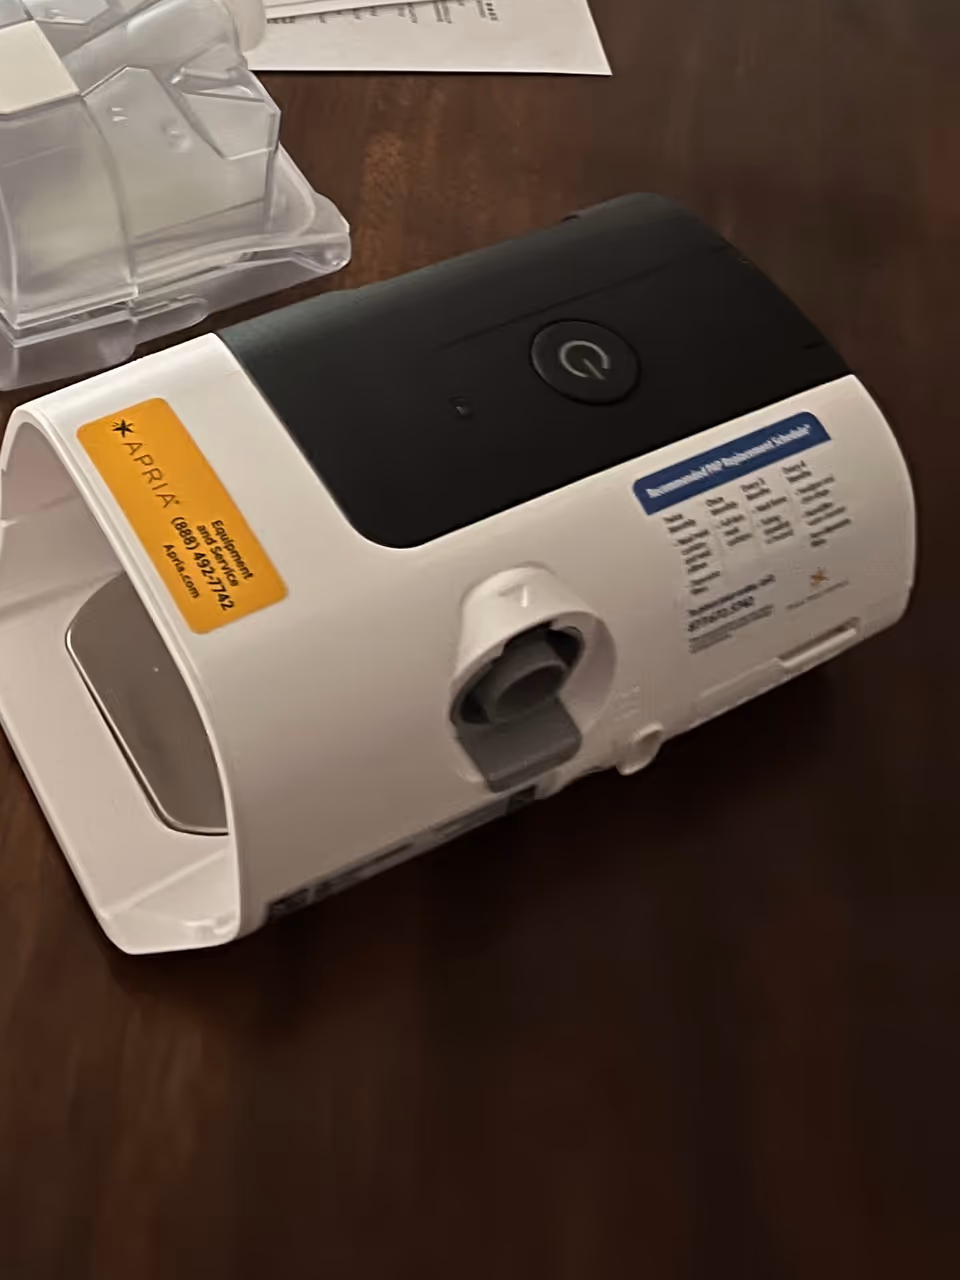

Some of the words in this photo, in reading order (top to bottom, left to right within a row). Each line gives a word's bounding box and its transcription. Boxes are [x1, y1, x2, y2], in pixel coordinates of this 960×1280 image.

[122, 442, 177, 508] APRIA
[162, 544, 200, 599] Apria.com
[170, 516, 200, 550] (888)
[193, 552, 235, 611] 492-7742
[196, 524, 217, 546] and
[210, 546, 239, 587] Service
[211, 519, 254, 580] Equipment
